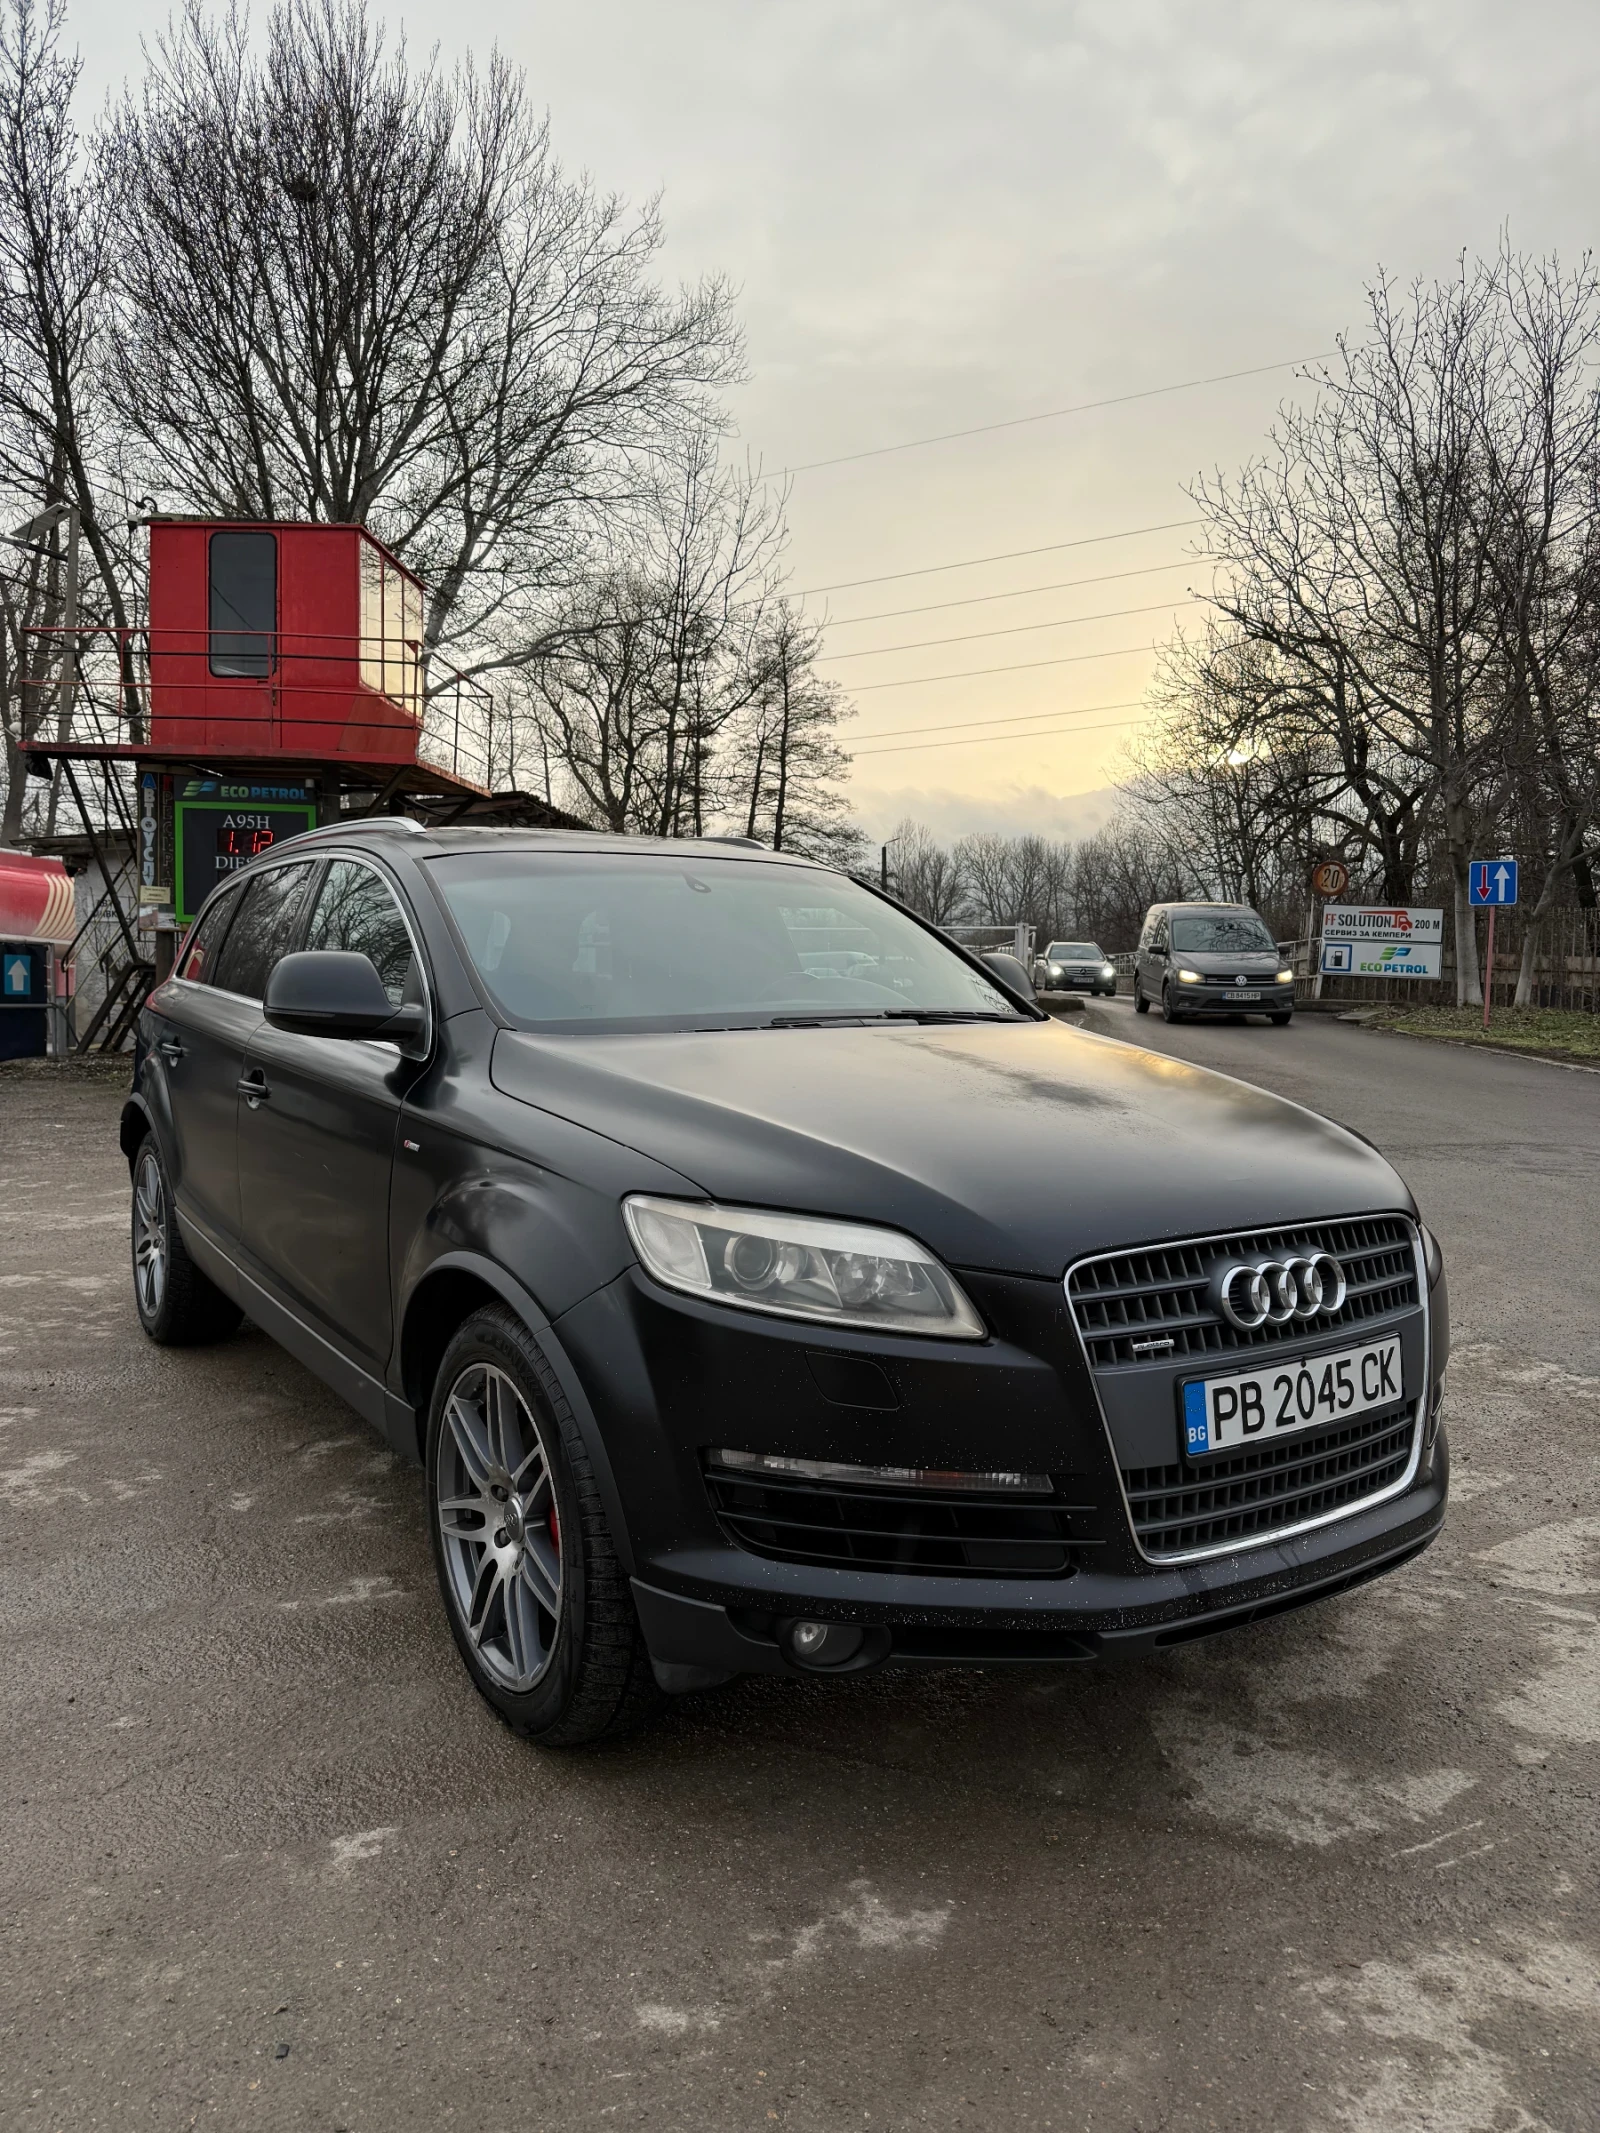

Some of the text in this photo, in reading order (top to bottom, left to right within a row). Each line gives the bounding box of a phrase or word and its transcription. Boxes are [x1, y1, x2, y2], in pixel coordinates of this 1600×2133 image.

[1321, 868, 1340, 889] 20
[1325, 913, 1336, 926] FF
[1338, 914, 1392, 928] SOLUTION
[1414, 919, 1431, 930] 200
[1325, 929, 1358, 937] СЕРВИЗ
[1372, 931, 1412, 939] КЕМПЕРИ
[1212, 1346, 1397, 1440] PB 2045 CK
[1188, 1426, 1206, 1443] BG
